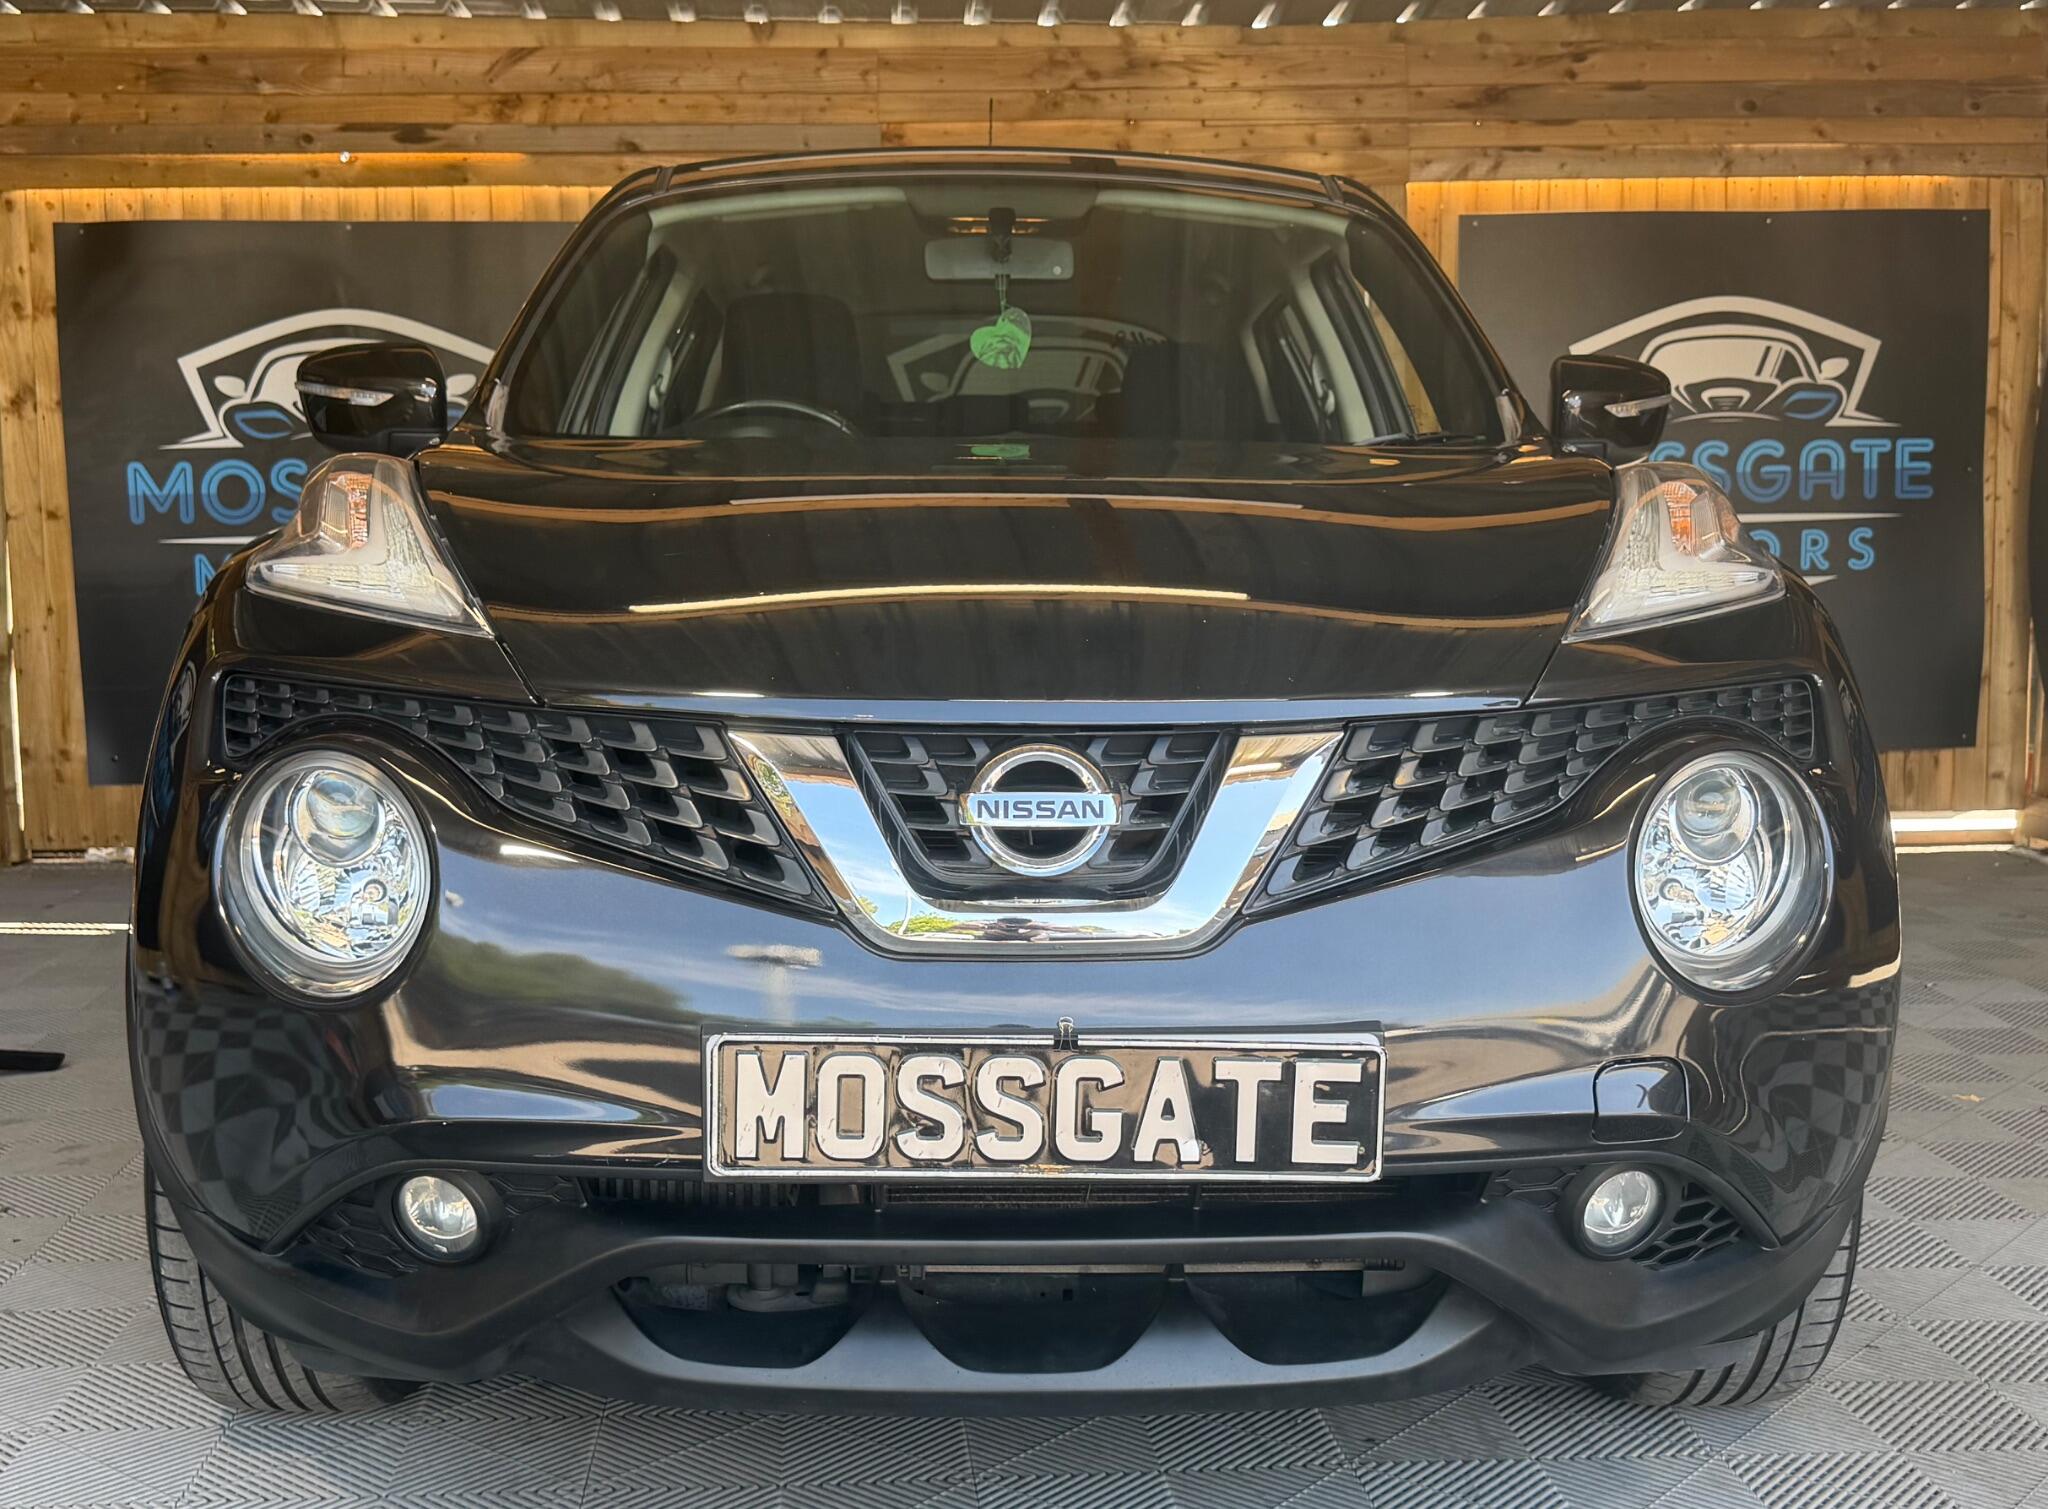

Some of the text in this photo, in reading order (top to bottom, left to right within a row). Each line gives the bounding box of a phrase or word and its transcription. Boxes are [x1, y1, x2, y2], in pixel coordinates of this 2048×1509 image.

[127, 459, 308, 525] MOS
[976, 800, 1104, 819] NISSAN
[734, 1050, 1363, 1165] MOSSGATE
